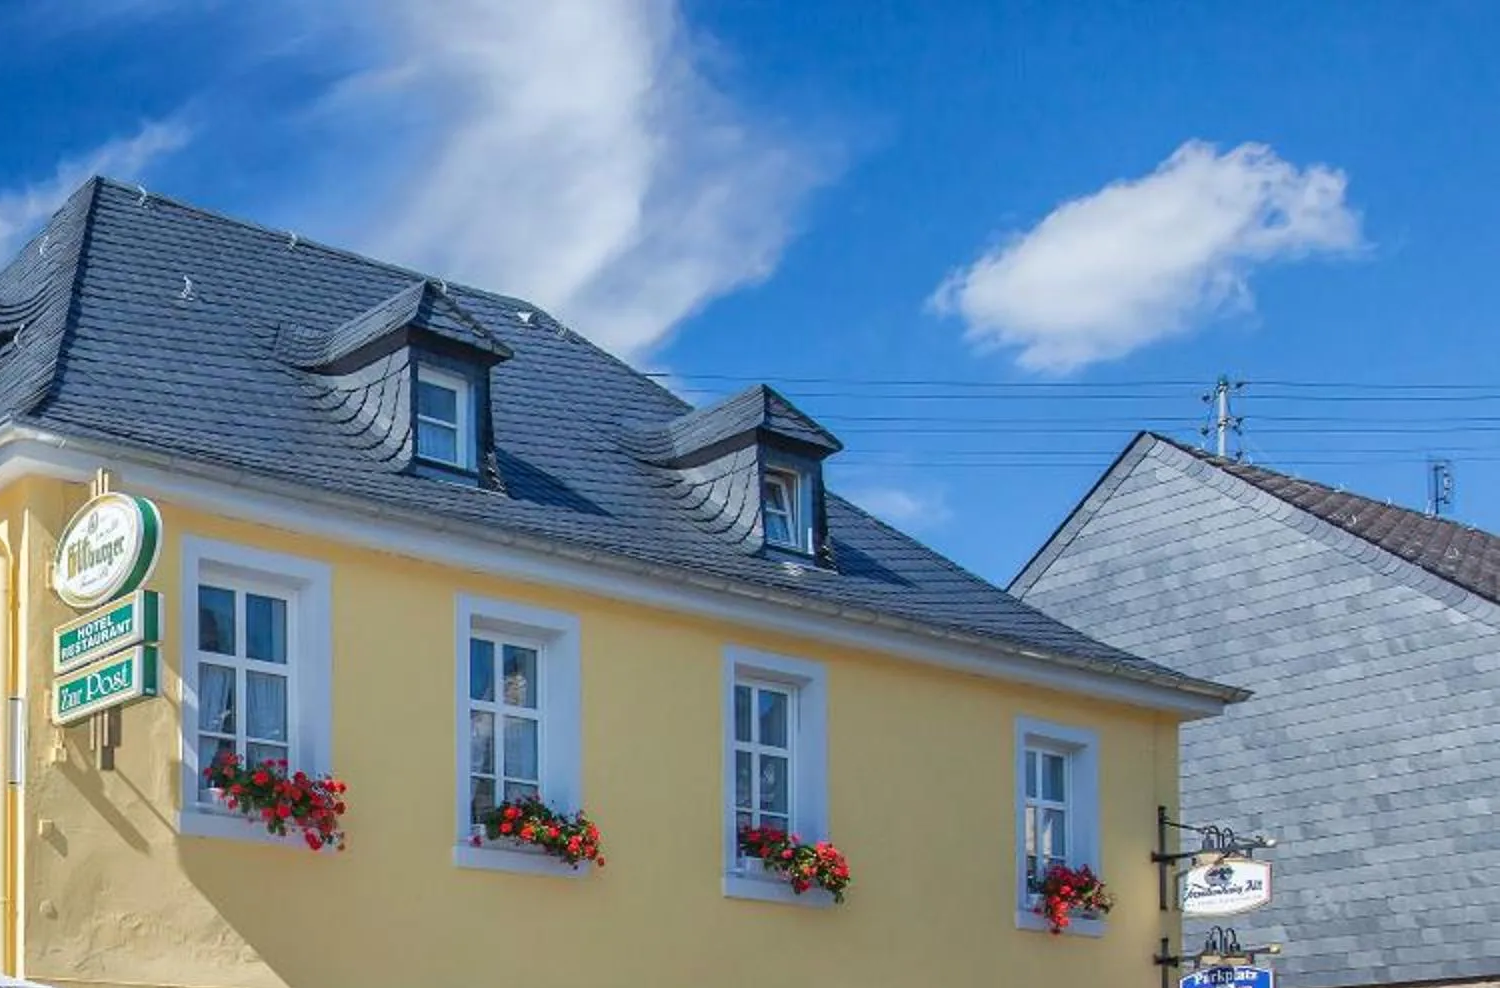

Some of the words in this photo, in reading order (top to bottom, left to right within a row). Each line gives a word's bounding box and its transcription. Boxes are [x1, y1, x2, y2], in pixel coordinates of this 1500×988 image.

[62, 619, 131, 660] RESTAURANT
[77, 615, 114, 640] HOTEL
[86, 662, 131, 701] Post
[1194, 968, 1259, 986] Parkplatz
